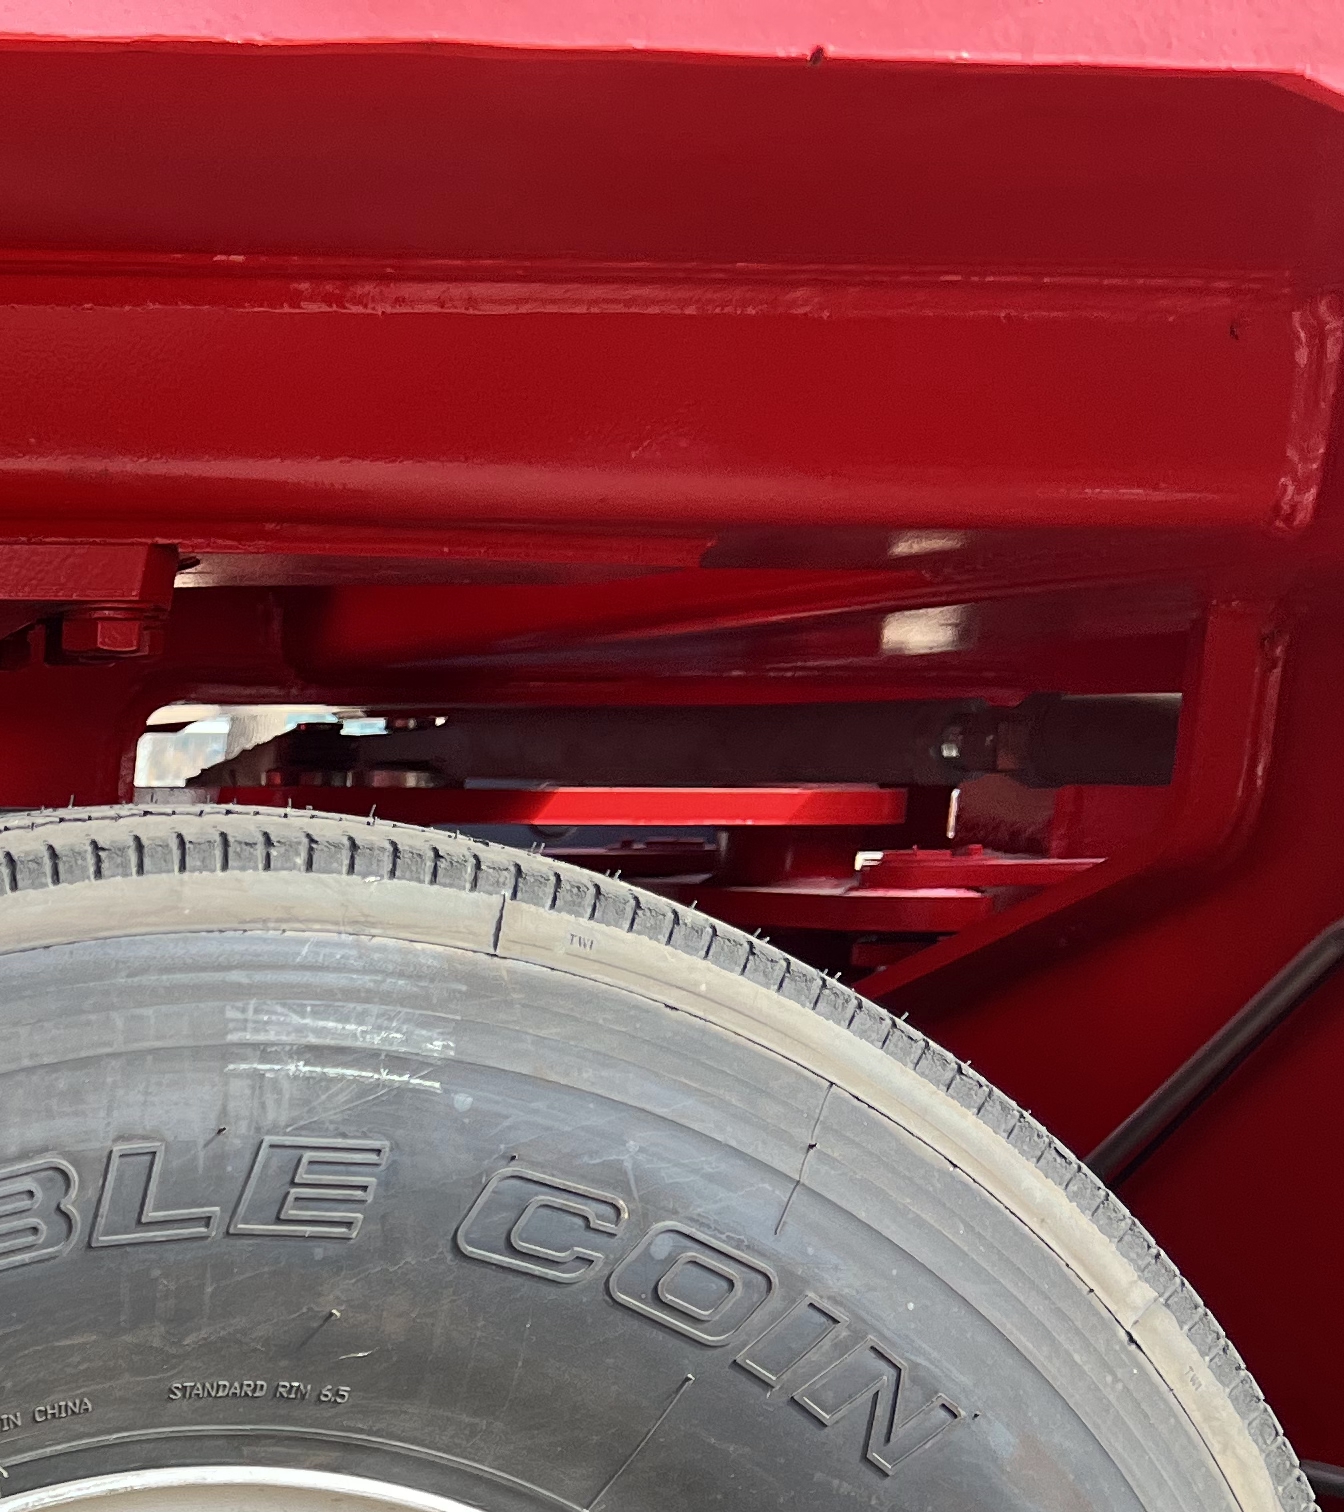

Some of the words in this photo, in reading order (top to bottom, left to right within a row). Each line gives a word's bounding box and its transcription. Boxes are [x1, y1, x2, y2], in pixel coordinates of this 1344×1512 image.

[452, 1166, 966, 1477] COIN
[167, 1379, 268, 1401] STANDARD
[275, 1380, 311, 1401] RIM
[318, 1382, 351, 1407] 6.5
[29, 1396, 93, 1423] CHINA
